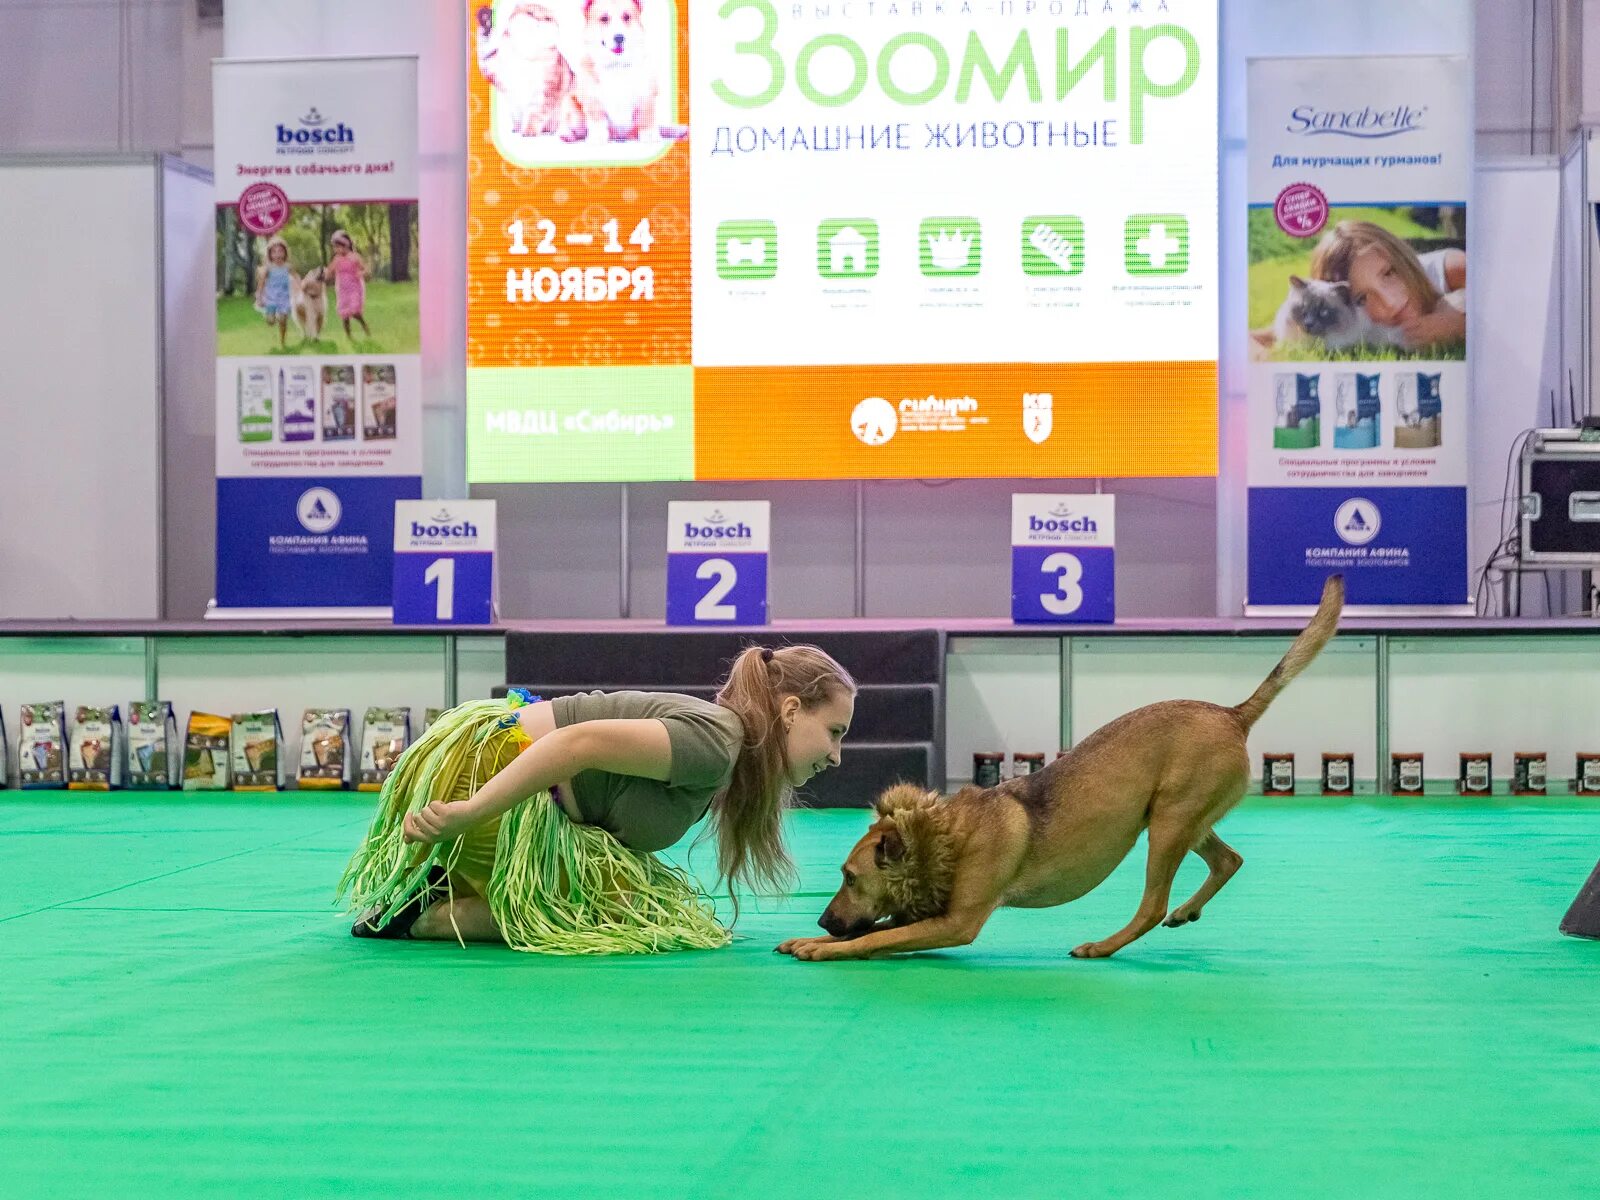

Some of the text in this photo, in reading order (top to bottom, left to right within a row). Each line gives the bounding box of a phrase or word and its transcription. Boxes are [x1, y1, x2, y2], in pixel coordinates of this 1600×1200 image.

[276, 122, 355, 144] bosch
[711, 119, 1119, 157] ДОМАШНИЕ ЖИВОТНЫЕ
[236, 159, 395, 177] Энергия собачьего дня!
[1272, 152, 1443, 169] Для мурчащих гурманов!
[505, 265, 655, 303] НОЯБРЯ
[485, 410, 559, 435] МВДЦ
[411, 520, 478, 538] bosch
[684, 521, 752, 538] bosch
[1028, 515, 1098, 533] bosch
[1305, 547, 1410, 558] КОМПАНИЯ АФИНА
[424, 557, 456, 620] 1
[695, 558, 737, 620] 2
[1040, 551, 1084, 616] 3
